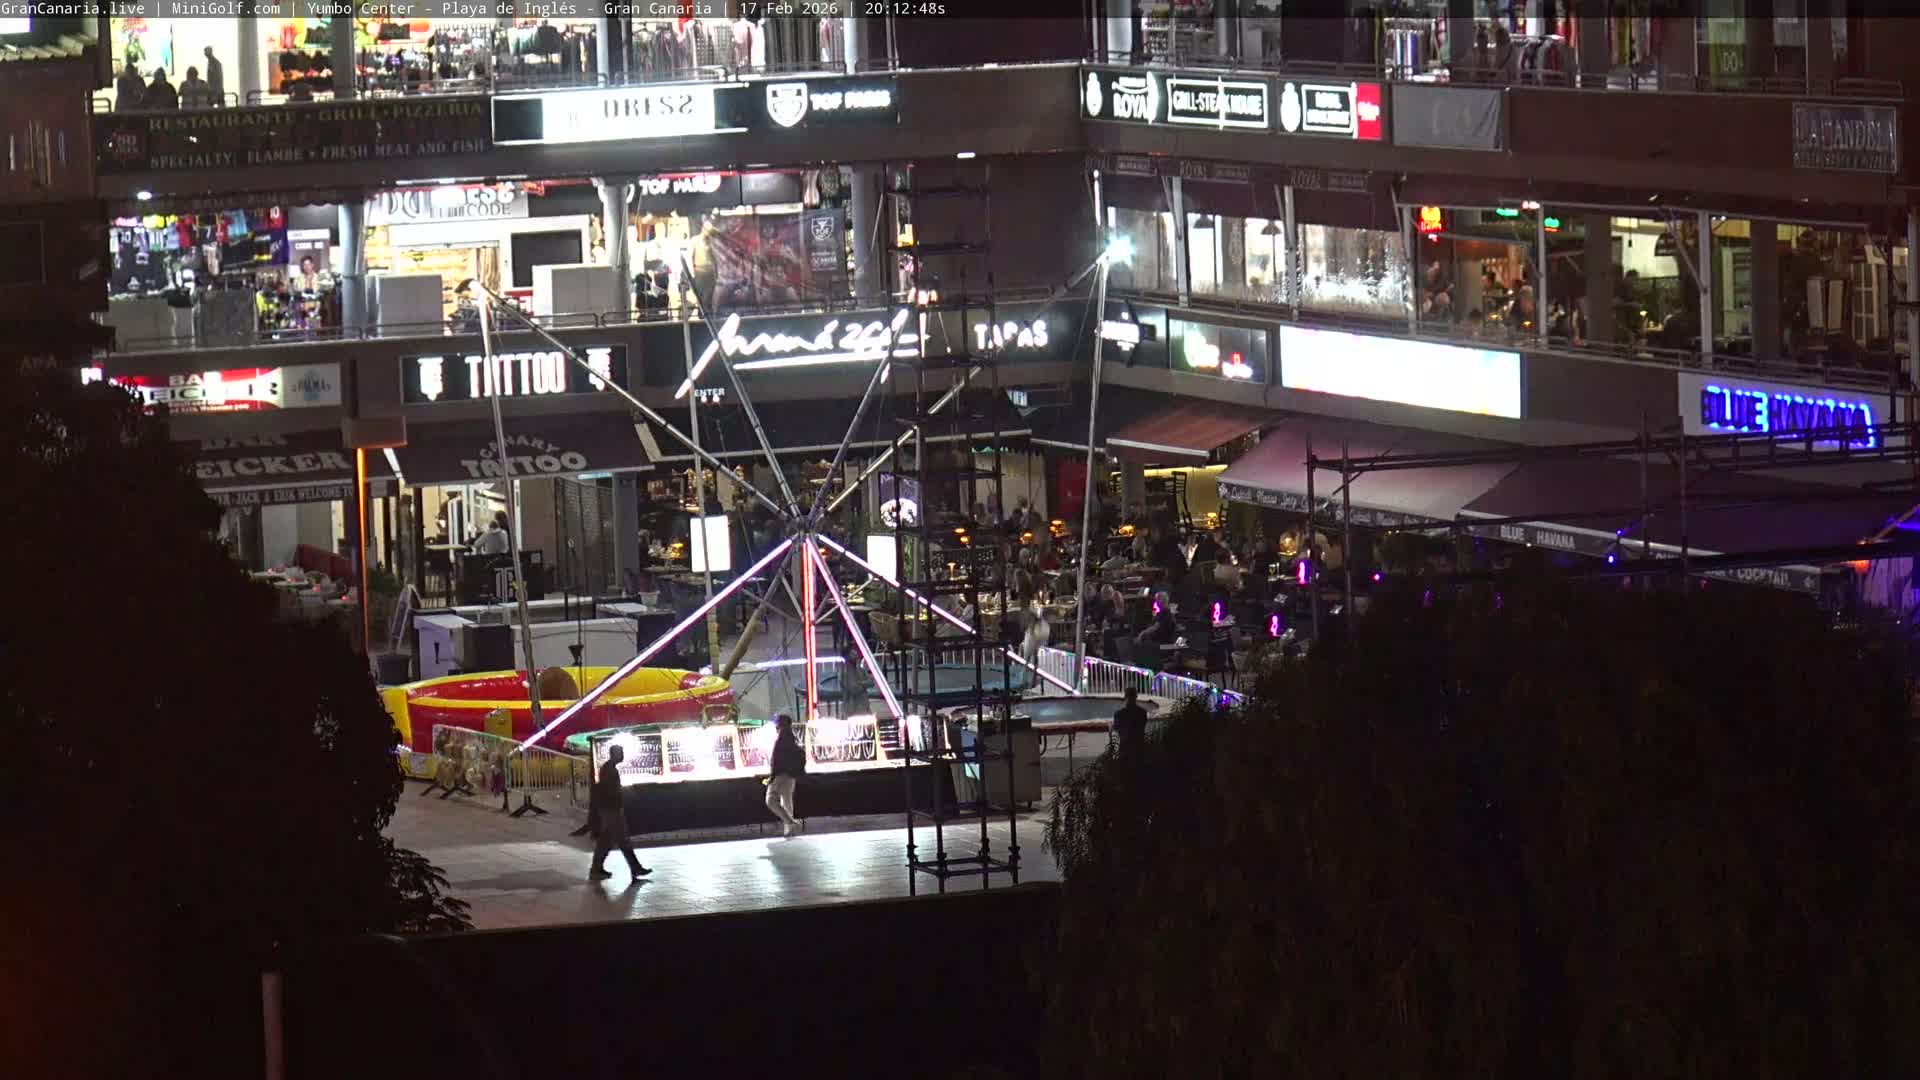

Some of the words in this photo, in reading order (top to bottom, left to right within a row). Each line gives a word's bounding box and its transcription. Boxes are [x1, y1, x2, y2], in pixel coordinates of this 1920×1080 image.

[149, 109, 297, 131] RESTAURANTE
[319, 103, 375, 121] GRILL
[418, 138, 447, 154] AND
[453, 136, 485, 152] FISH
[467, 202, 512, 217] CODE
[973, 319, 1049, 350] TAPAS
[168, 371, 222, 387] BA
[464, 352, 567, 398] TATTOO
[460, 451, 588, 479] TATTOO
[1500, 524, 1525, 542] BLUE
[1536, 530, 1577, 551] HAVANA
